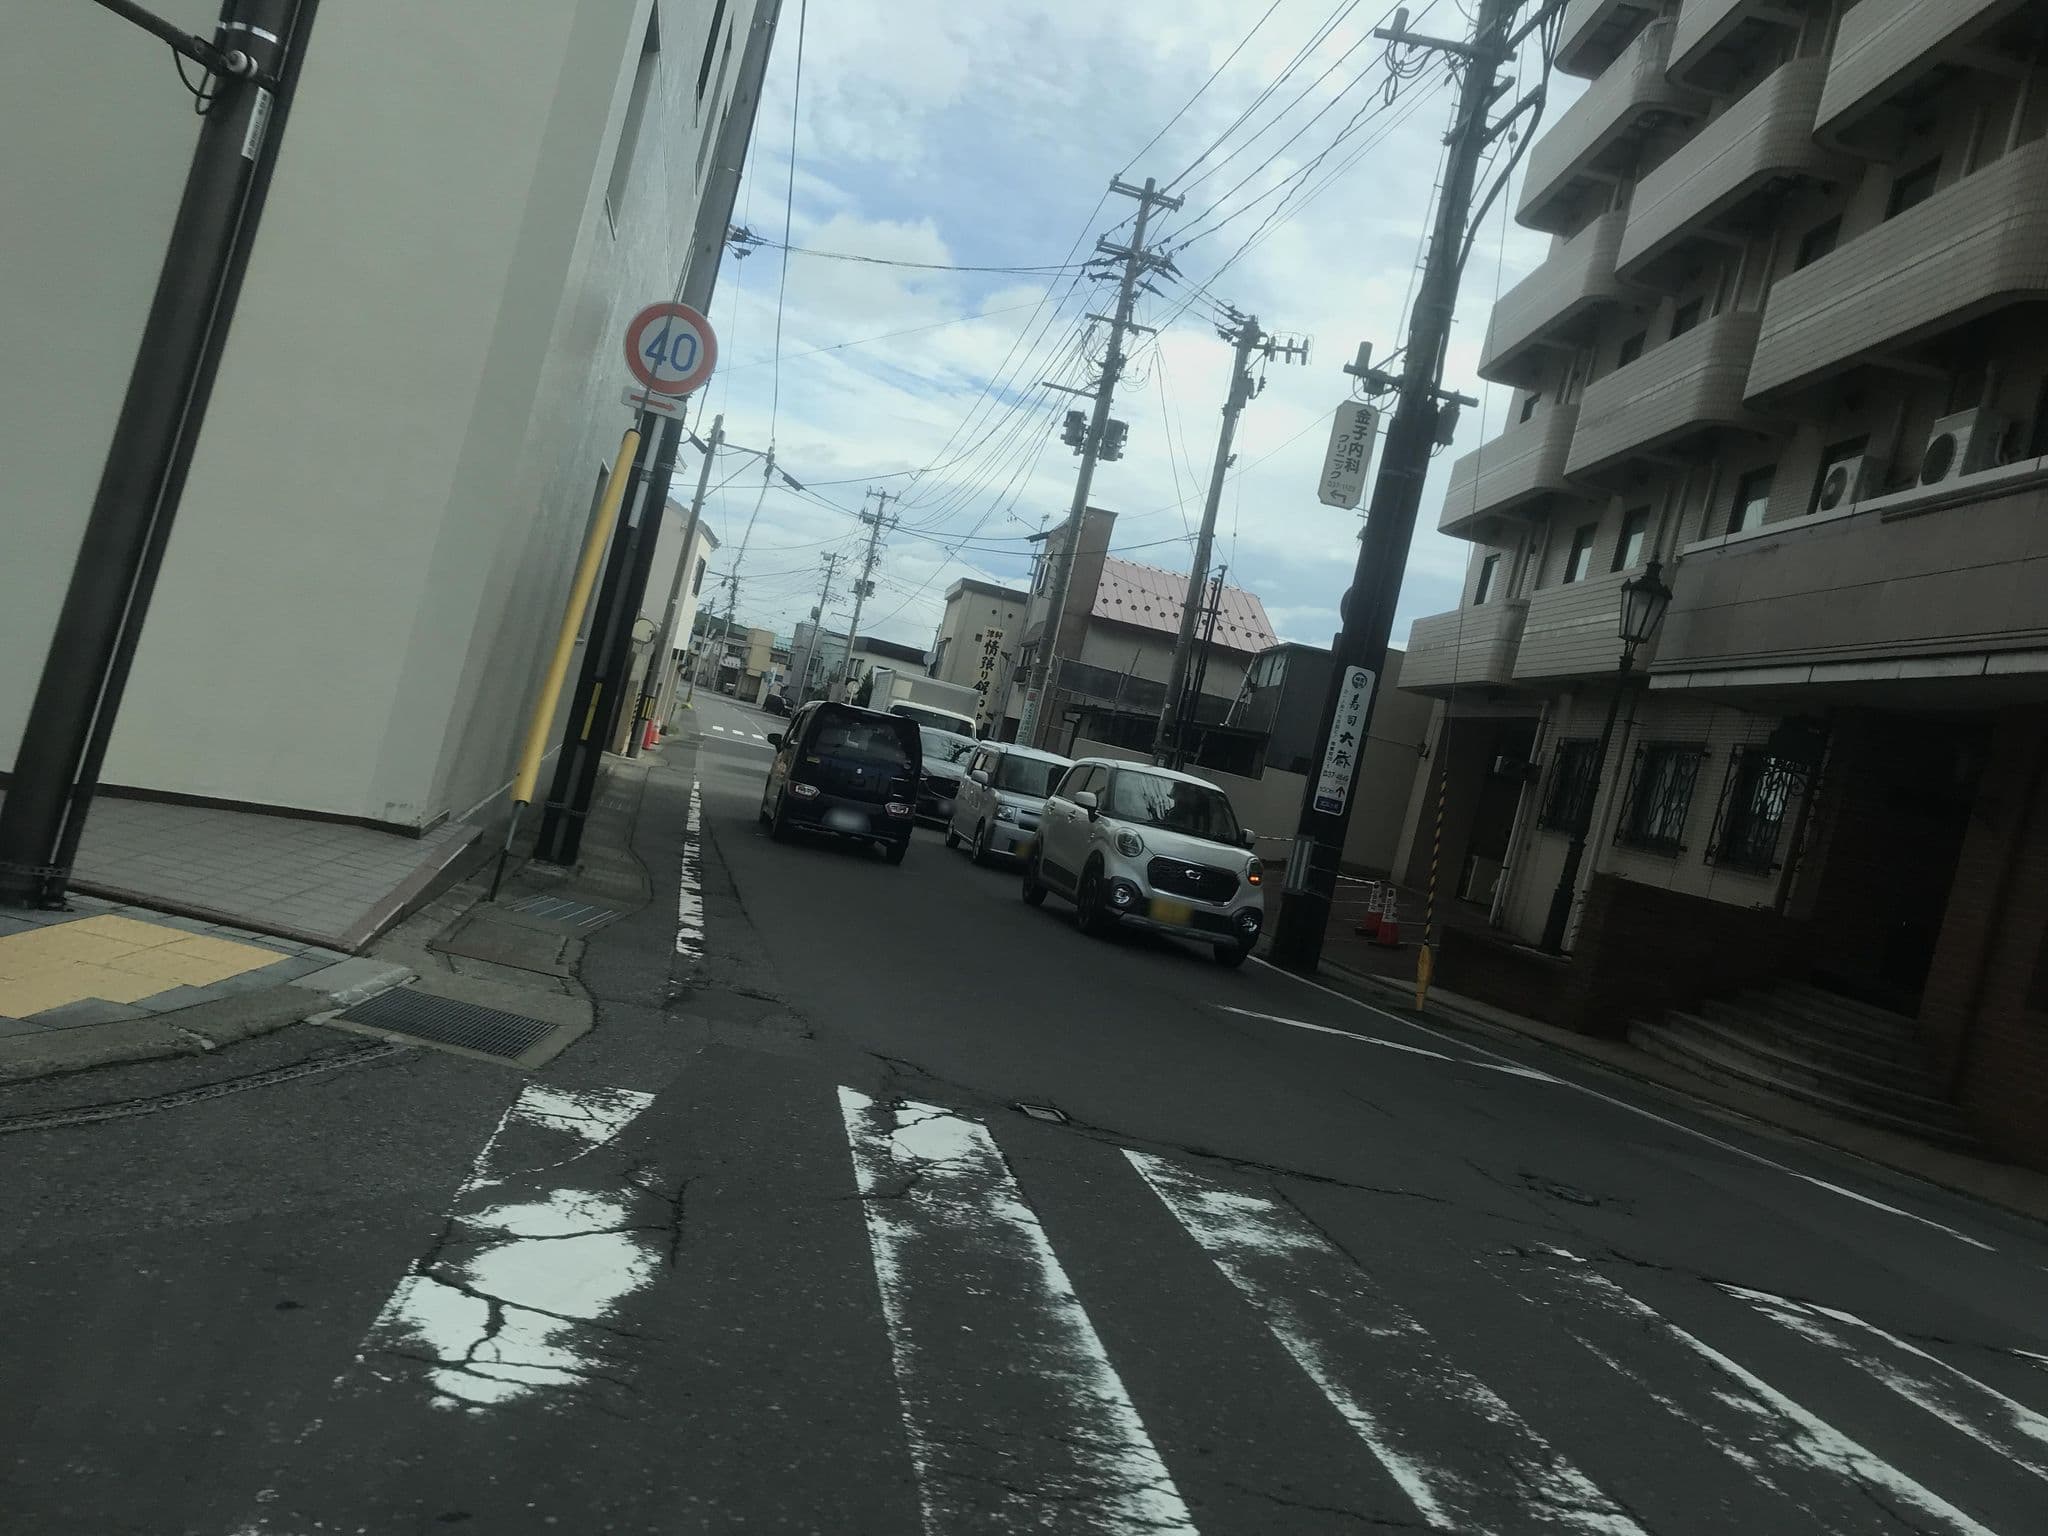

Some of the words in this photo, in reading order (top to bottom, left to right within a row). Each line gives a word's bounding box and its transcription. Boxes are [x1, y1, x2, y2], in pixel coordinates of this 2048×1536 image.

[645, 327, 697, 372] 40
[1330, 434, 1350, 480] クリニック
[1344, 409, 1371, 474] 金子内科
